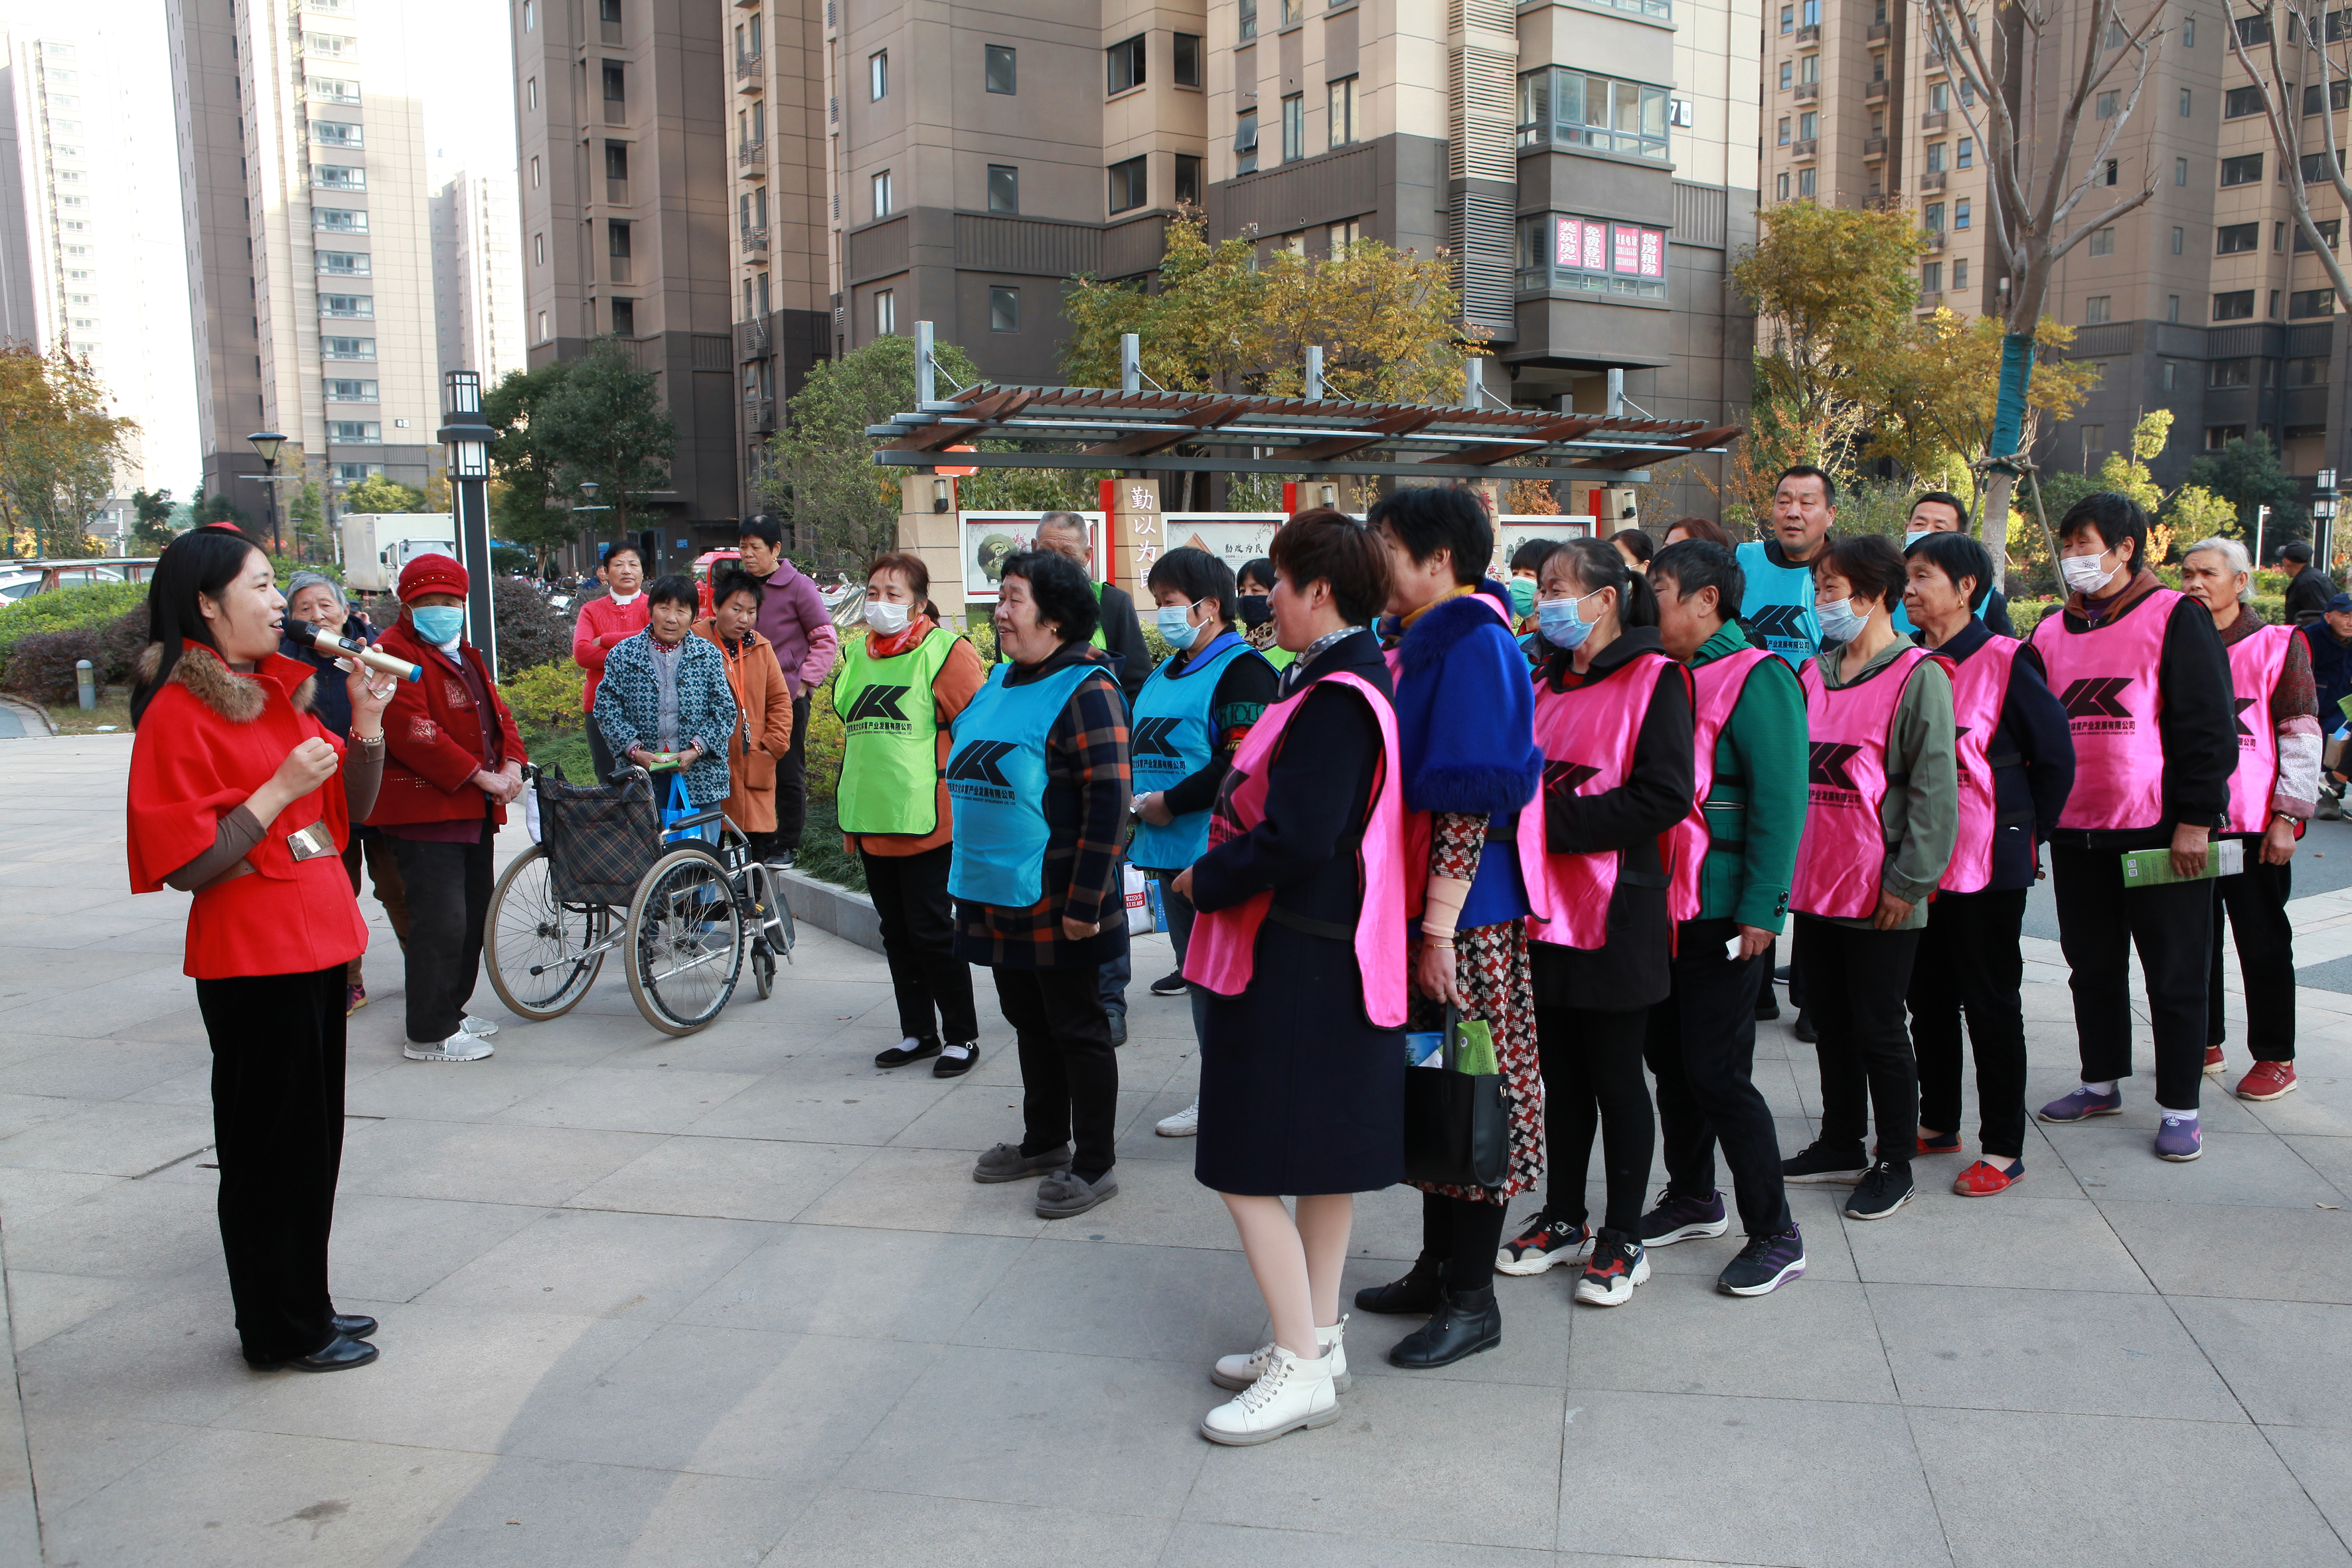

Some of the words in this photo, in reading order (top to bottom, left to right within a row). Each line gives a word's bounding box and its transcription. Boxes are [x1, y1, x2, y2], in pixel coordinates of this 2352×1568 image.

[1559, 221, 1577, 264] 美筑房产
[1584, 225, 1601, 268] 免费登记
[1615, 234, 1638, 246] 联系电话
[1641, 233, 1658, 274] 售房租房
[1766, 640, 1809, 649] 产业发展有限公司
[2069, 721, 2135, 731] 体育产业发展有限公司
